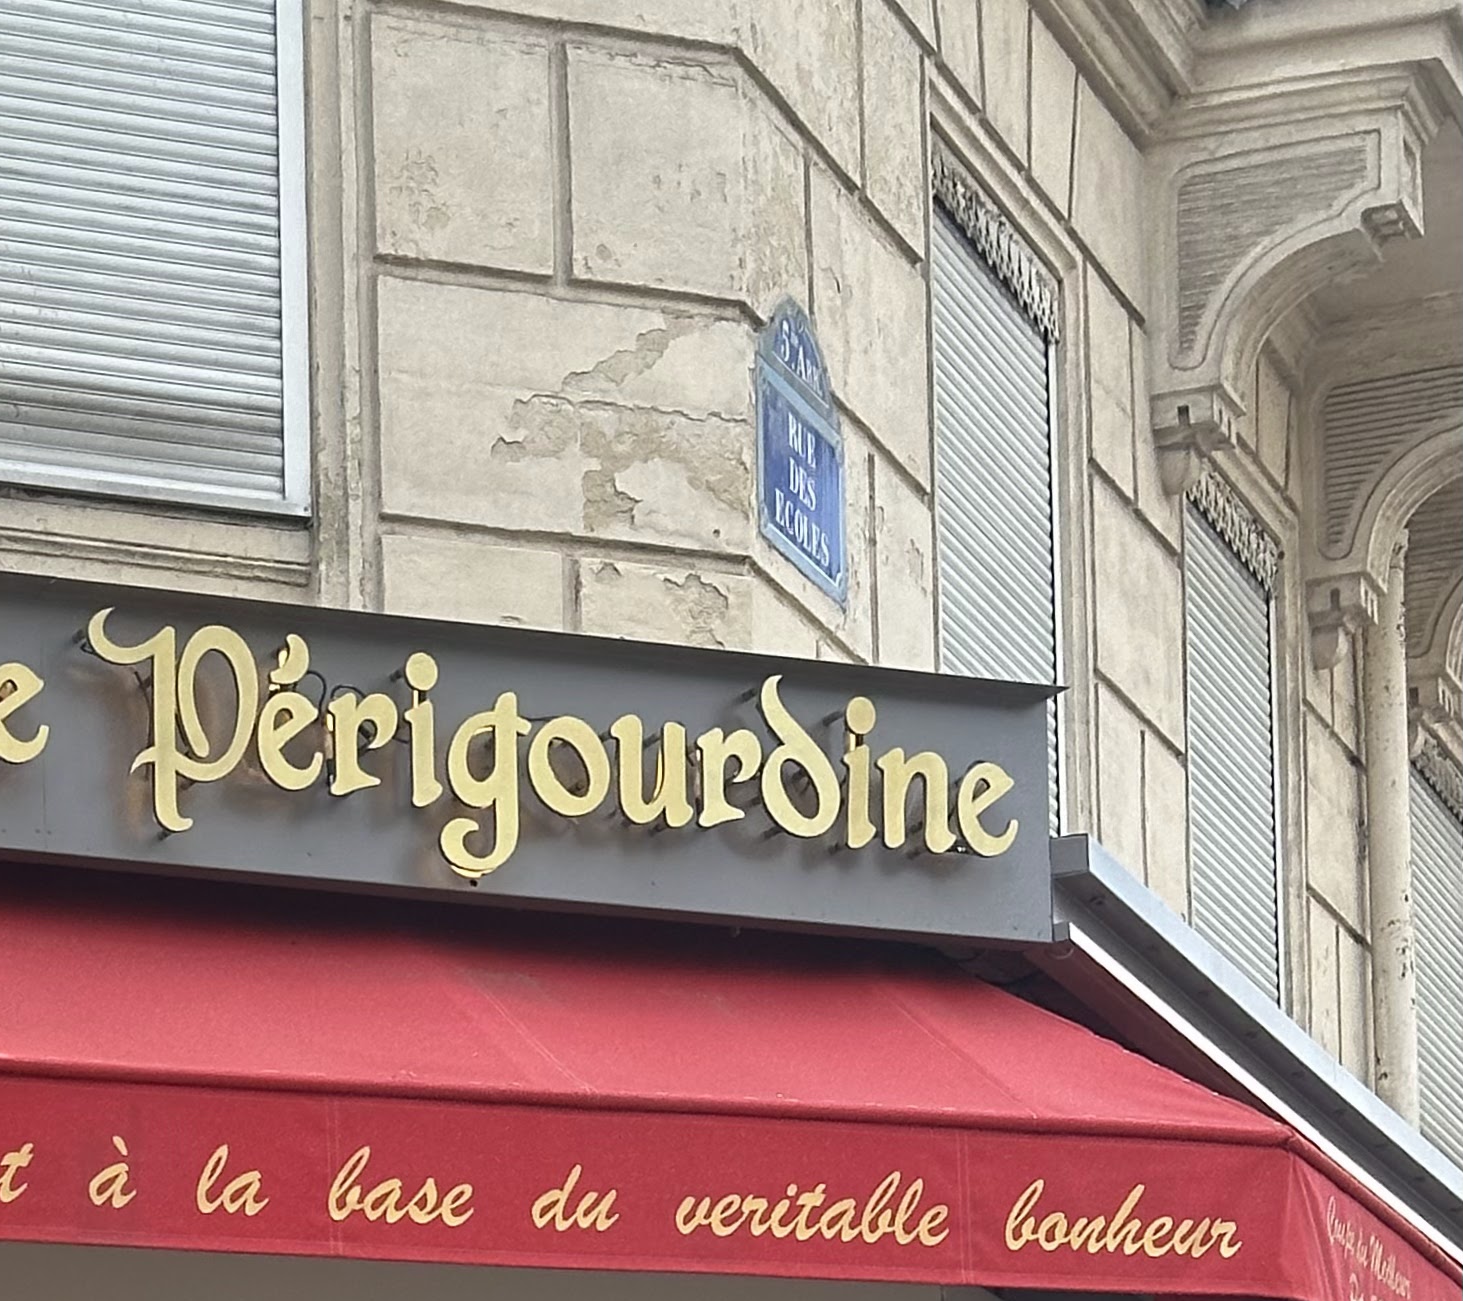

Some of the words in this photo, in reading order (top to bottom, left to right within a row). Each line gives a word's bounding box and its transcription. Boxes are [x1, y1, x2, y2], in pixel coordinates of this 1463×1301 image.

[788, 412, 816, 470] RUE
[788, 456, 816, 511] DES
[774, 487, 831, 569] ECOLES
[86, 606, 1020, 880] Périgourdine
[88, 1135, 137, 1209] à
[196, 1143, 270, 1217] la
[327, 1145, 474, 1227] base
[531, 1163, 620, 1235] du
[673, 1170, 951, 1247] veritable
[1003, 1178, 1244, 1261] bonheur
